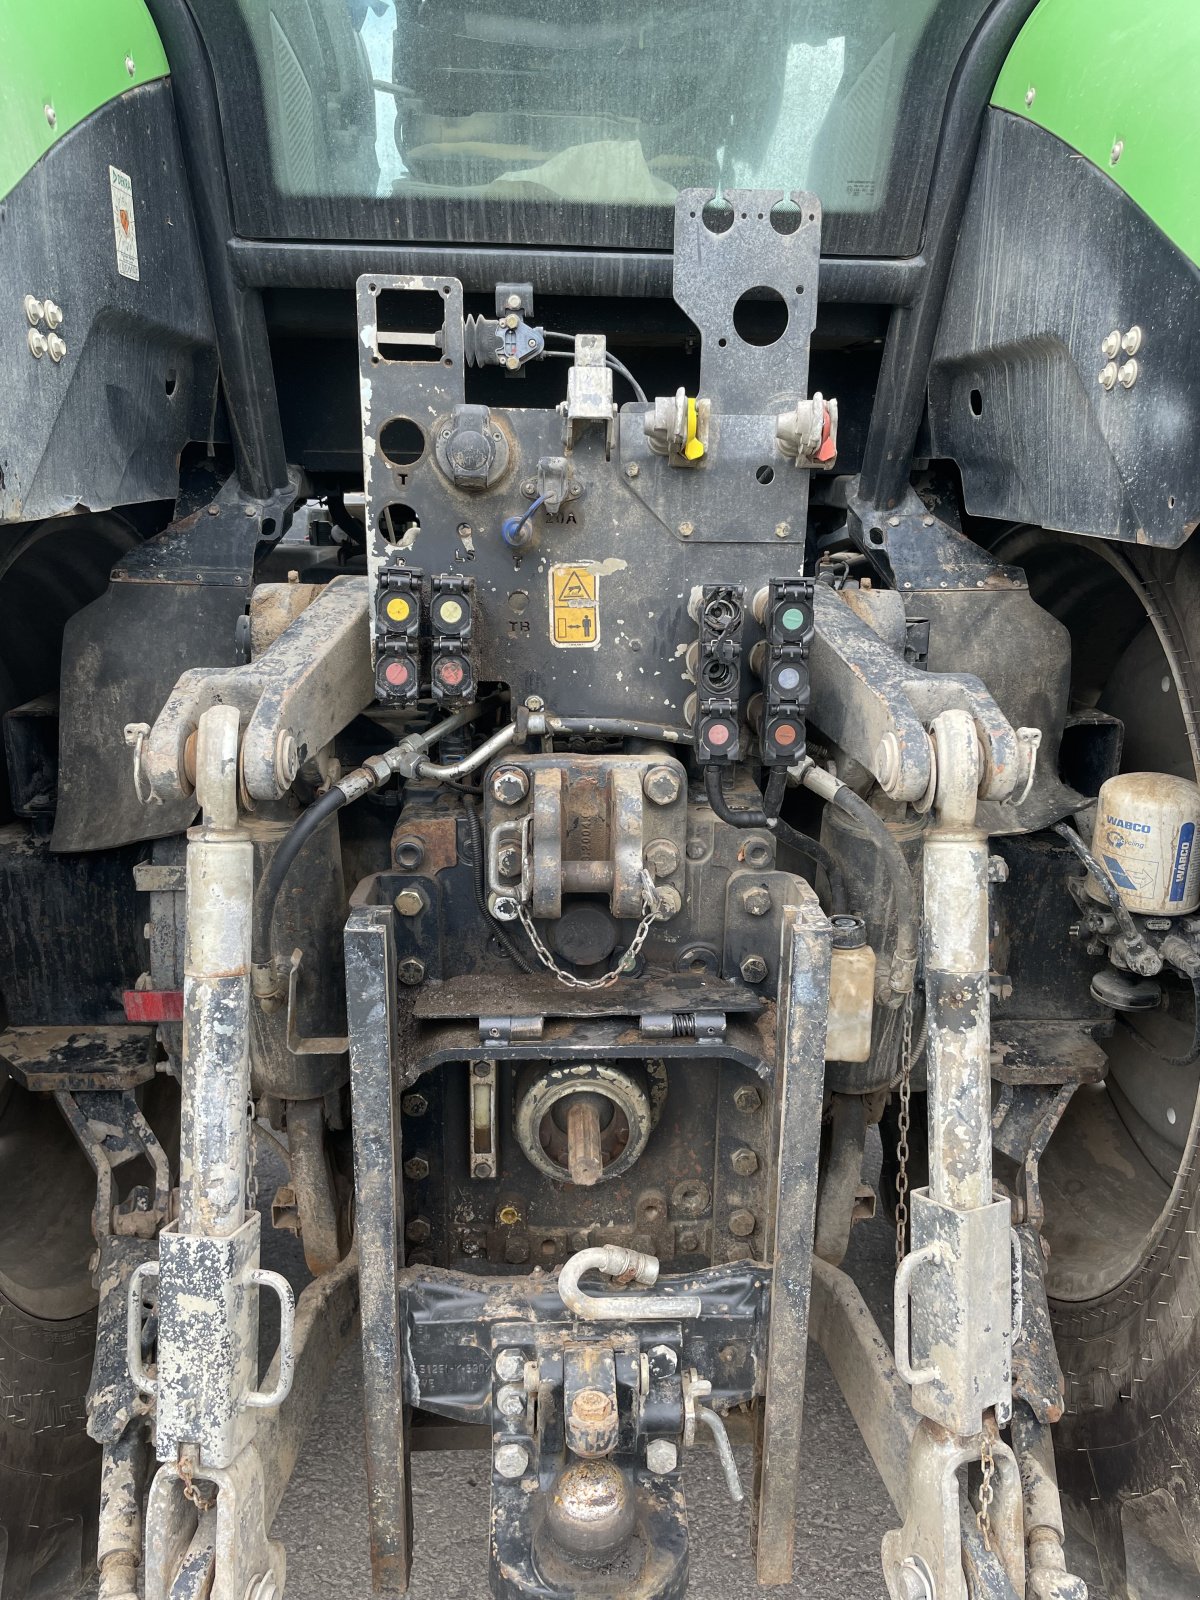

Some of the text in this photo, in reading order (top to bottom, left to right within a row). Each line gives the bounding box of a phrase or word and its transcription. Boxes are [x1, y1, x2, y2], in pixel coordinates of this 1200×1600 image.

[398, 473, 408, 485] T
[455, 548, 475, 561] LS
[1107, 815, 1151, 833] WABCO
[1176, 842, 1190, 882] WABCO
